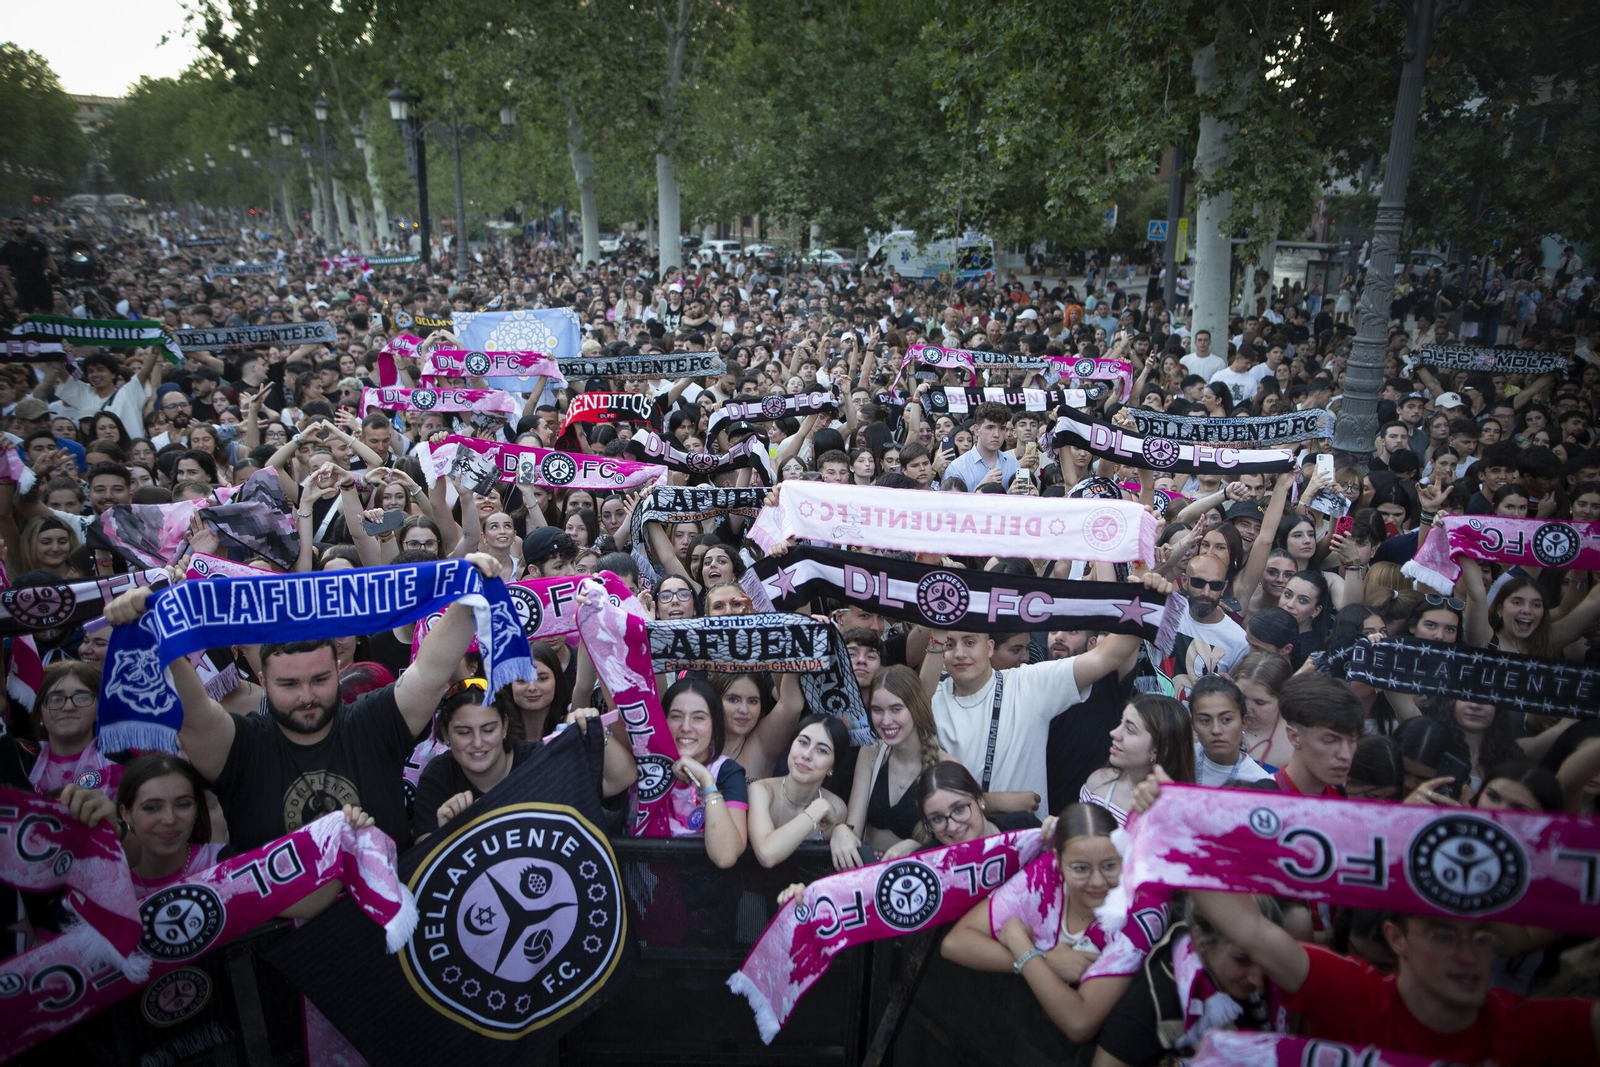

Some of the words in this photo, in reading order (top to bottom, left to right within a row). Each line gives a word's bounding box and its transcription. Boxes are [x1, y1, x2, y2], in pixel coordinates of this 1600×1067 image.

[6, 340, 41, 357] FC
[178, 326, 302, 346] DELLAFUENTE
[437, 356, 460, 370] DL
[495, 355, 520, 370] FC
[558, 359, 687, 376] DELLAFUENTE
[691, 356, 712, 370] FC
[947, 351, 966, 362] FC
[1053, 361, 1069, 372] DL
[1099, 362, 1120, 373] FC
[1497, 355, 1555, 369] MDLR
[384, 390, 406, 403] DL
[442, 391, 466, 404] FC
[726, 402, 757, 420] DL
[794, 391, 824, 411] FC
[1134, 415, 1289, 441] DELLAFUENTE
[1291, 415, 1318, 435] FC
[644, 432, 679, 465] DL
[728, 434, 758, 465] FC
[1090, 422, 1133, 457] DL
[1193, 444, 1239, 468] FC
[505, 454, 518, 472] D
[583, 461, 617, 479] FC
[1481, 527, 1524, 555] FC
[844, 564, 905, 610] DL
[987, 587, 1055, 624] FC
[919, 575, 969, 598] DELLAFUENTE
[703, 616, 754, 628] Diciembre
[755, 615, 781, 626] 2022
[935, 614, 949, 623] F.C.
[648, 624, 834, 661] LAFUEN
[665, 662, 697, 671] Palacio
[700, 662, 713, 670] de
[714, 661, 728, 670] los
[729, 662, 771, 673] deportes
[772, 660, 824, 671] GRANADA
[1352, 646, 1594, 698] DELLAFUENTE
[618, 700, 656, 747] DL
[983, 719, 999, 782] SUPREME
[231, 839, 306, 898] DL
[1279, 828, 1389, 889] FC
[954, 854, 1006, 896] DL
[424, 828, 580, 962] DELLAFUENTE
[812, 890, 867, 937] FC
[1133, 902, 1168, 948] D
[150, 910, 217, 956] DELLAFUENTE
[541, 961, 581, 994] F.C.
